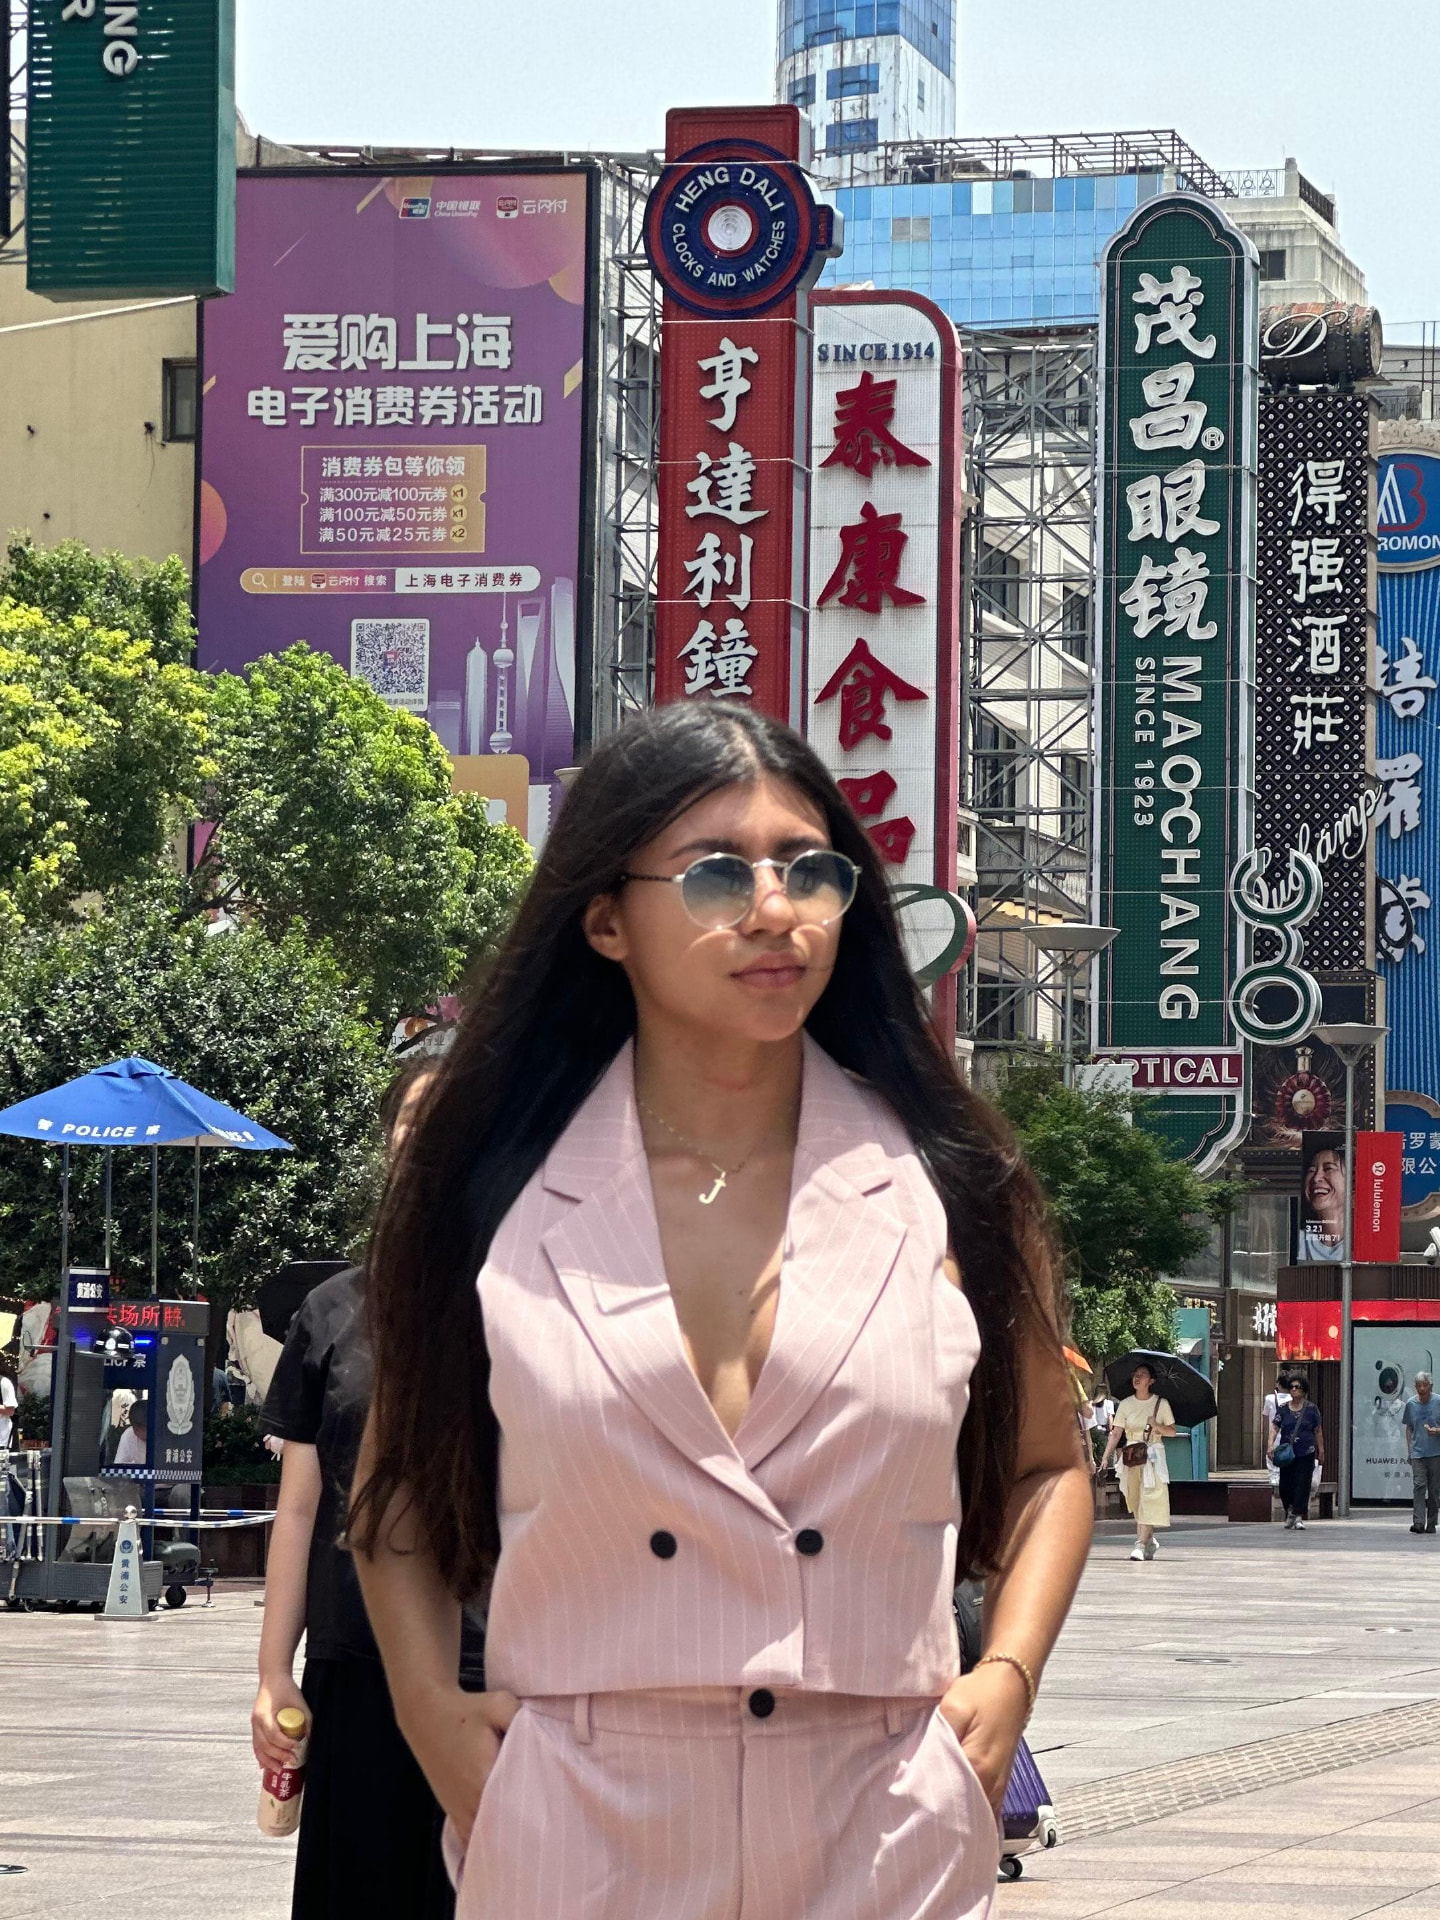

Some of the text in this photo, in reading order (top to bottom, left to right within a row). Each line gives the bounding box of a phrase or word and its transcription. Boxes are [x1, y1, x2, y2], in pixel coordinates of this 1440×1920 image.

[103, 0, 139, 76] NG
[675, 166, 785, 212] HENG DALI
[673, 220, 785, 287] CLOCKS AND WATCHES
[283, 312, 512, 371] 爱购上海
[817, 341, 935, 361] SINCE 1914
[247, 383, 543, 427] 电子消费券活动
[321, 455, 466, 478] 消费券包等你领
[319, 486, 448, 503] 满300元减100元券
[319, 506, 448, 523] 满100元减50元券
[318, 526, 448, 543] 满50元减25元券
[404, 572, 524, 588] 上海电子消费券
[1133, 656, 1155, 826] SINCE 1923
[1158, 655, 1202, 1021] MAOCHANG
[1097, 1056, 1239, 1084] TICAL
[61, 1123, 138, 1138] POLICE
[1402, 1131, 1440, 1151] 罗蒙
[1372, 1179, 1384, 1232] lululemon
[1366, 1457, 1398, 1465] HUAWEI
